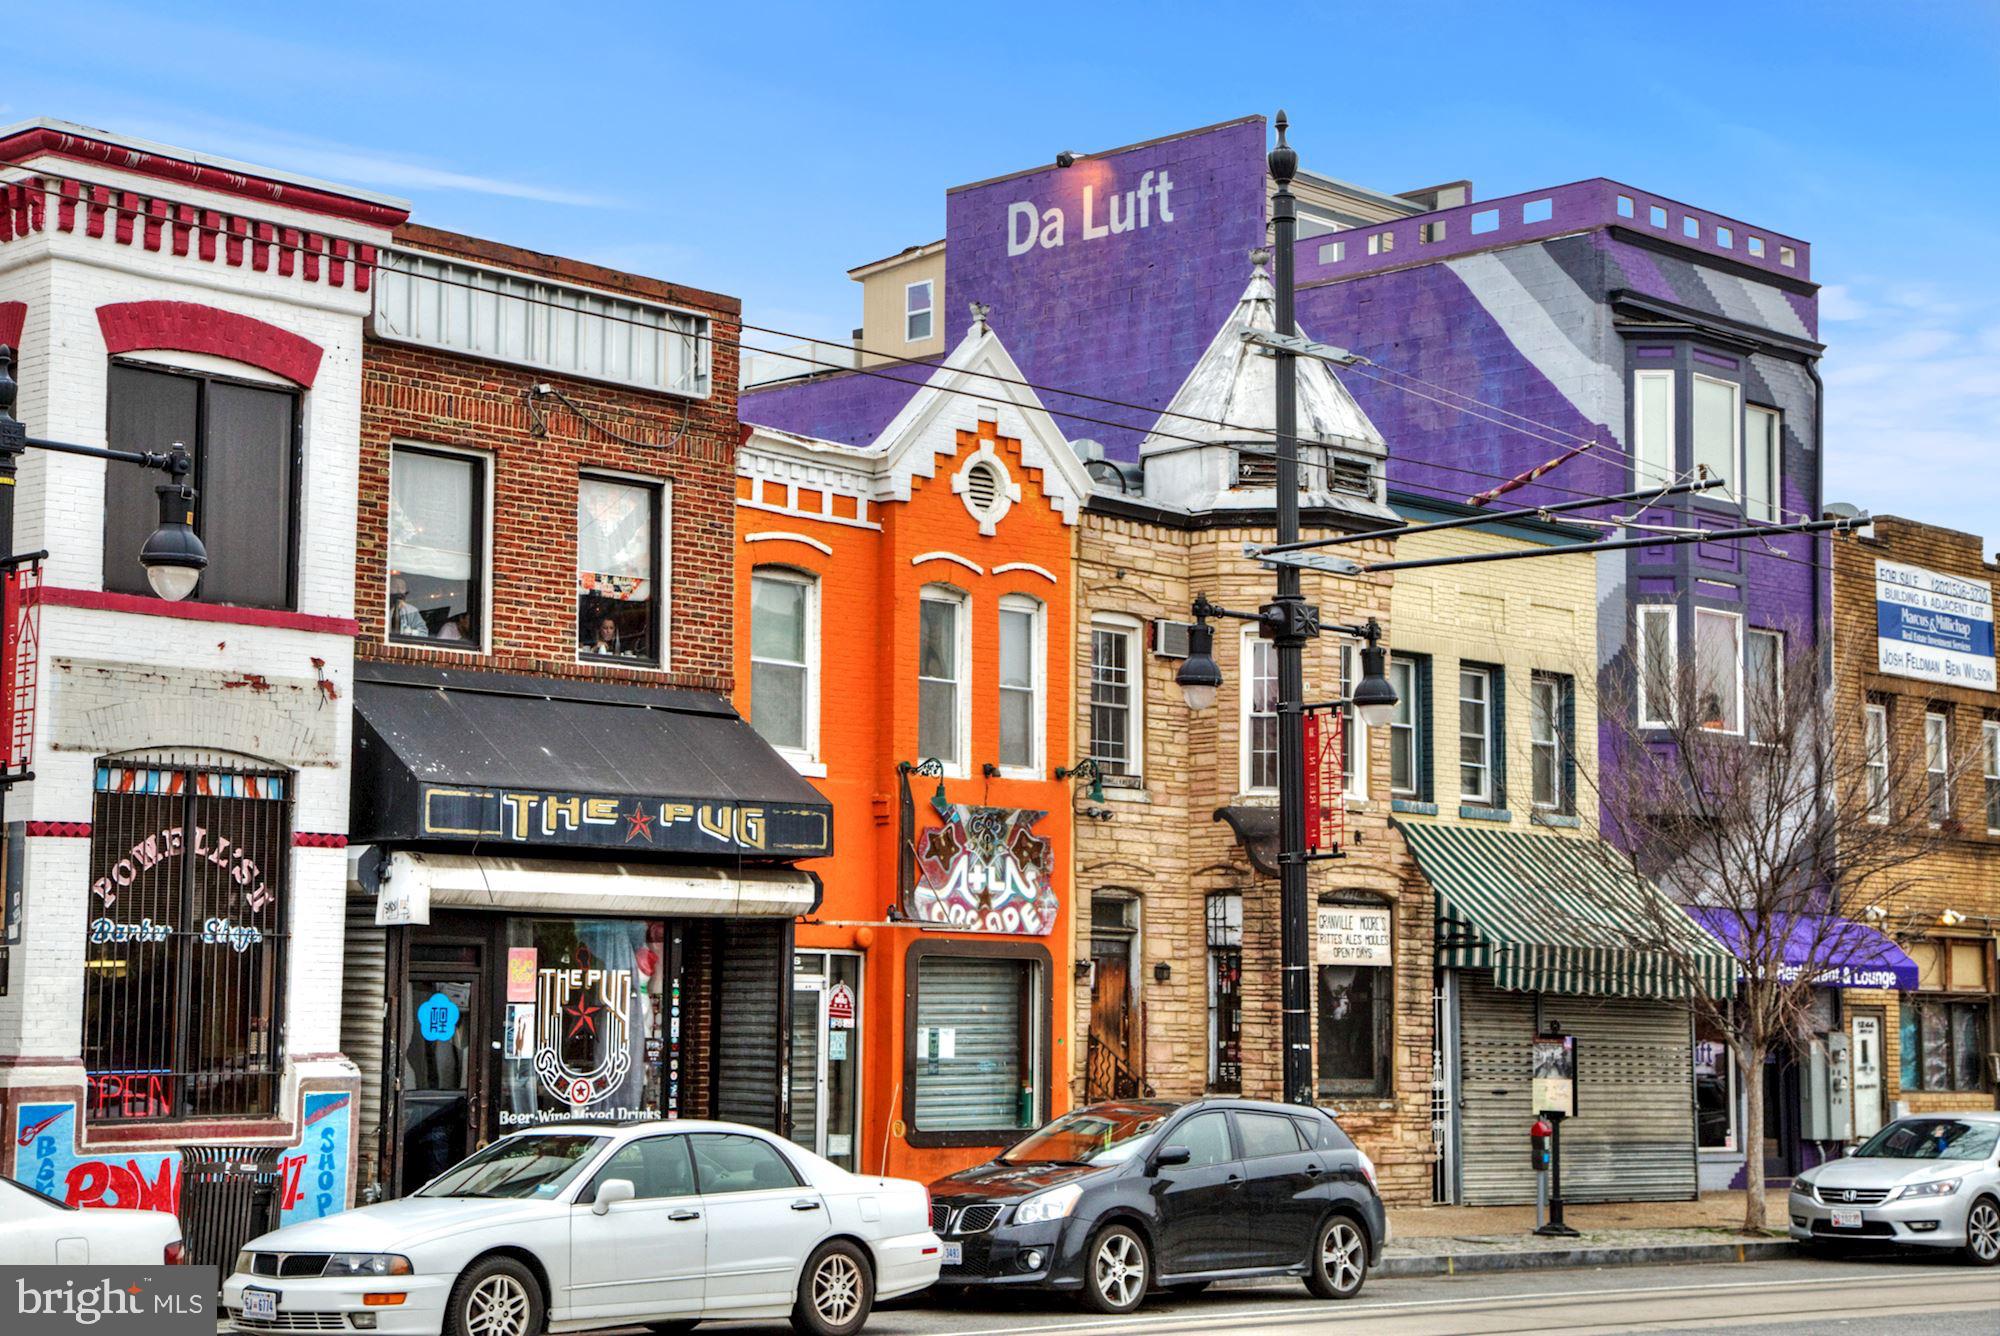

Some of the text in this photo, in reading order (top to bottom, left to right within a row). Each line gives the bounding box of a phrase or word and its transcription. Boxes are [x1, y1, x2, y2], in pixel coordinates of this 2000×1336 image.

[1008, 170, 1174, 257] Da Luft
[1880, 568, 1896, 582] FOR
[1900, 571, 1918, 586] SALE
[1884, 588, 1919, 605] BUILDING
[1931, 597, 1968, 614] ADJACENT
[1970, 606, 1984, 618] LOT
[1901, 607, 1971, 638] Marcus & Millichap
[1906, 652, 1940, 673] FELDMAN
[1945, 660, 1961, 676] BEN
[1963, 664, 1993, 682] WILSON
[503, 794, 766, 849] THE PUG
[92, 826, 260, 909] POWELL'S
[1318, 914, 1386, 931] GRANVILLE MOORE'S
[1333, 947, 1351, 958] OPEN
[1356, 946, 1373, 959] DAYS
[1346, 934, 1362, 946] ALES
[1365, 934, 1390, 946] MOULES
[1843, 966, 1852, 984] &
[1855, 968, 1897, 990] Lounge
[86, 1074, 173, 1117] PEN
[500, 1110, 534, 1125] Beer
[618, 1107, 662, 1120] Drinks
[317, 1127, 336, 1218] SHOP
